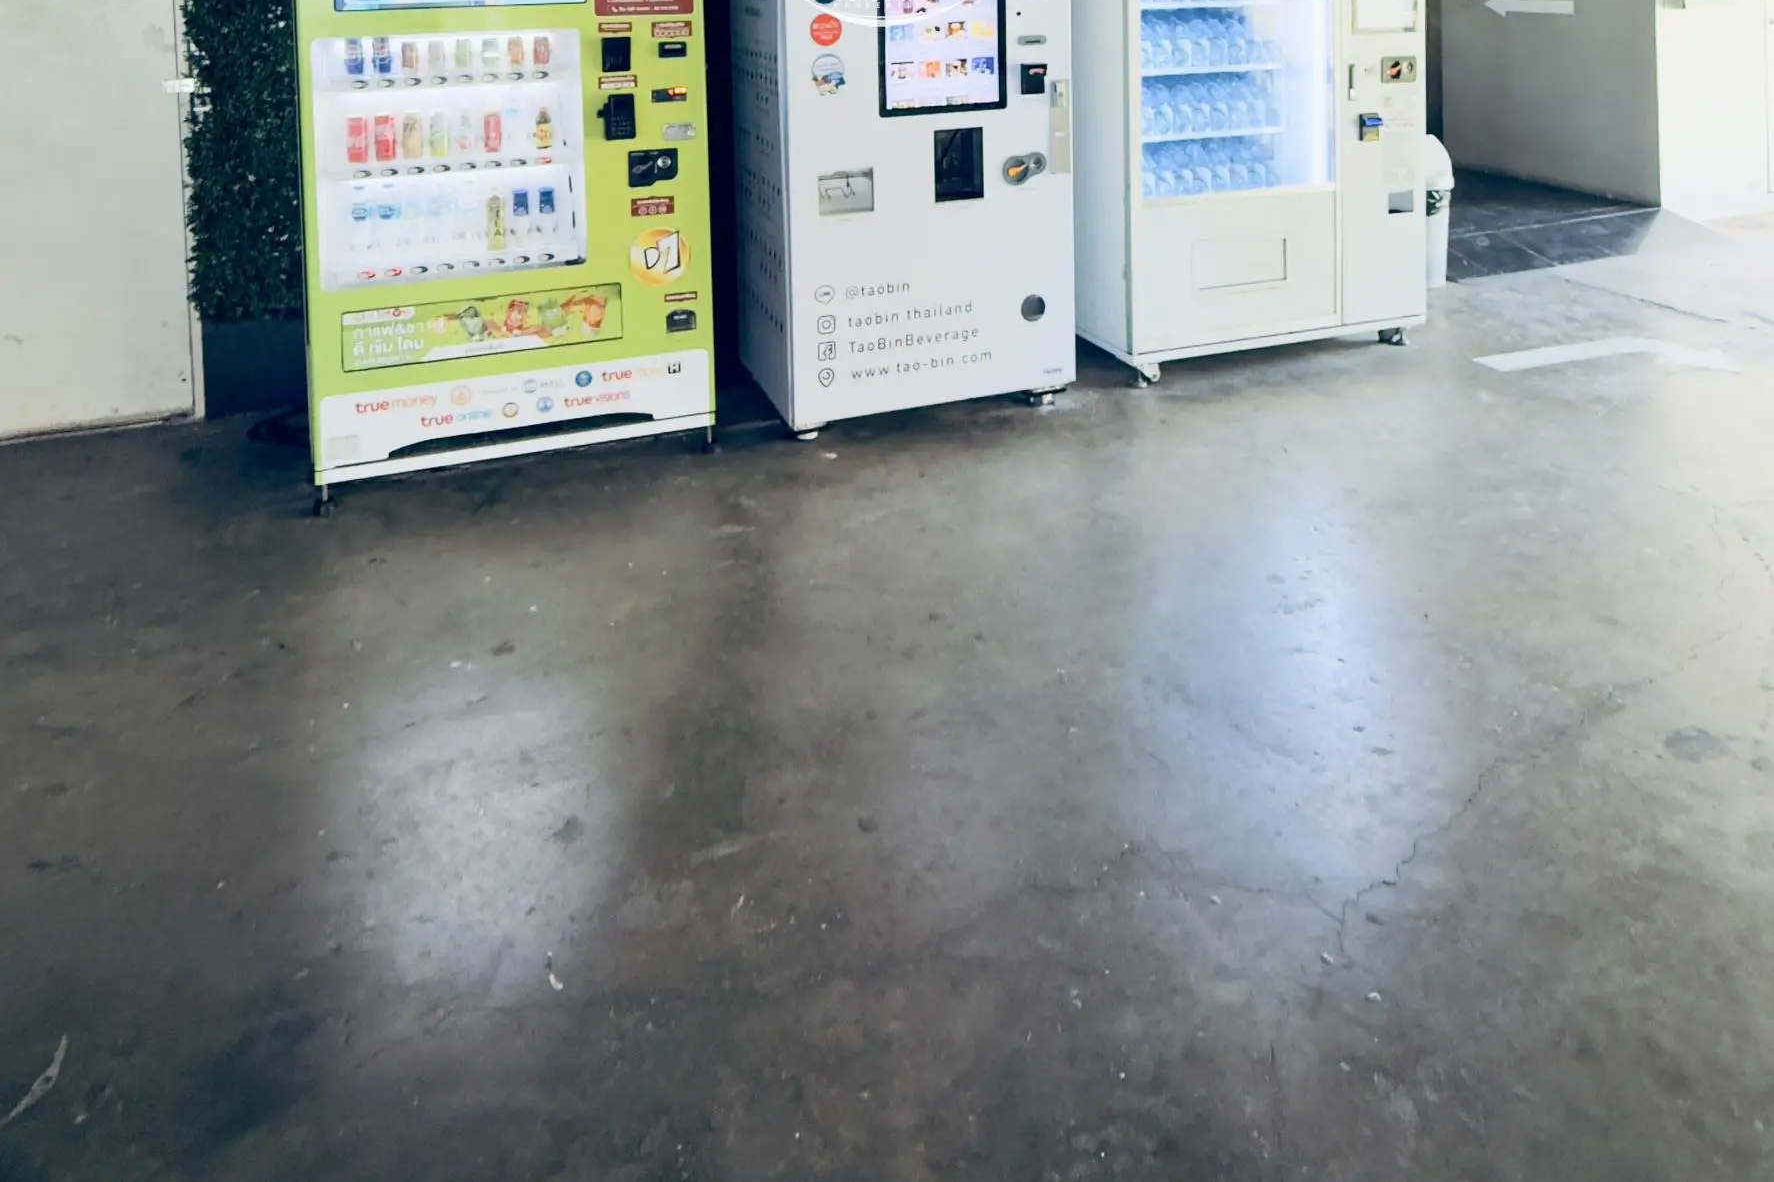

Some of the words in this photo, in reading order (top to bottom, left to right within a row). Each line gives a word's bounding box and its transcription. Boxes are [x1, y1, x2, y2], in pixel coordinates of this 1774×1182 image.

[846, 282, 910, 300] @taobin
[849, 328, 979, 354] TaoBinBeverage
[602, 370, 633, 382] true
